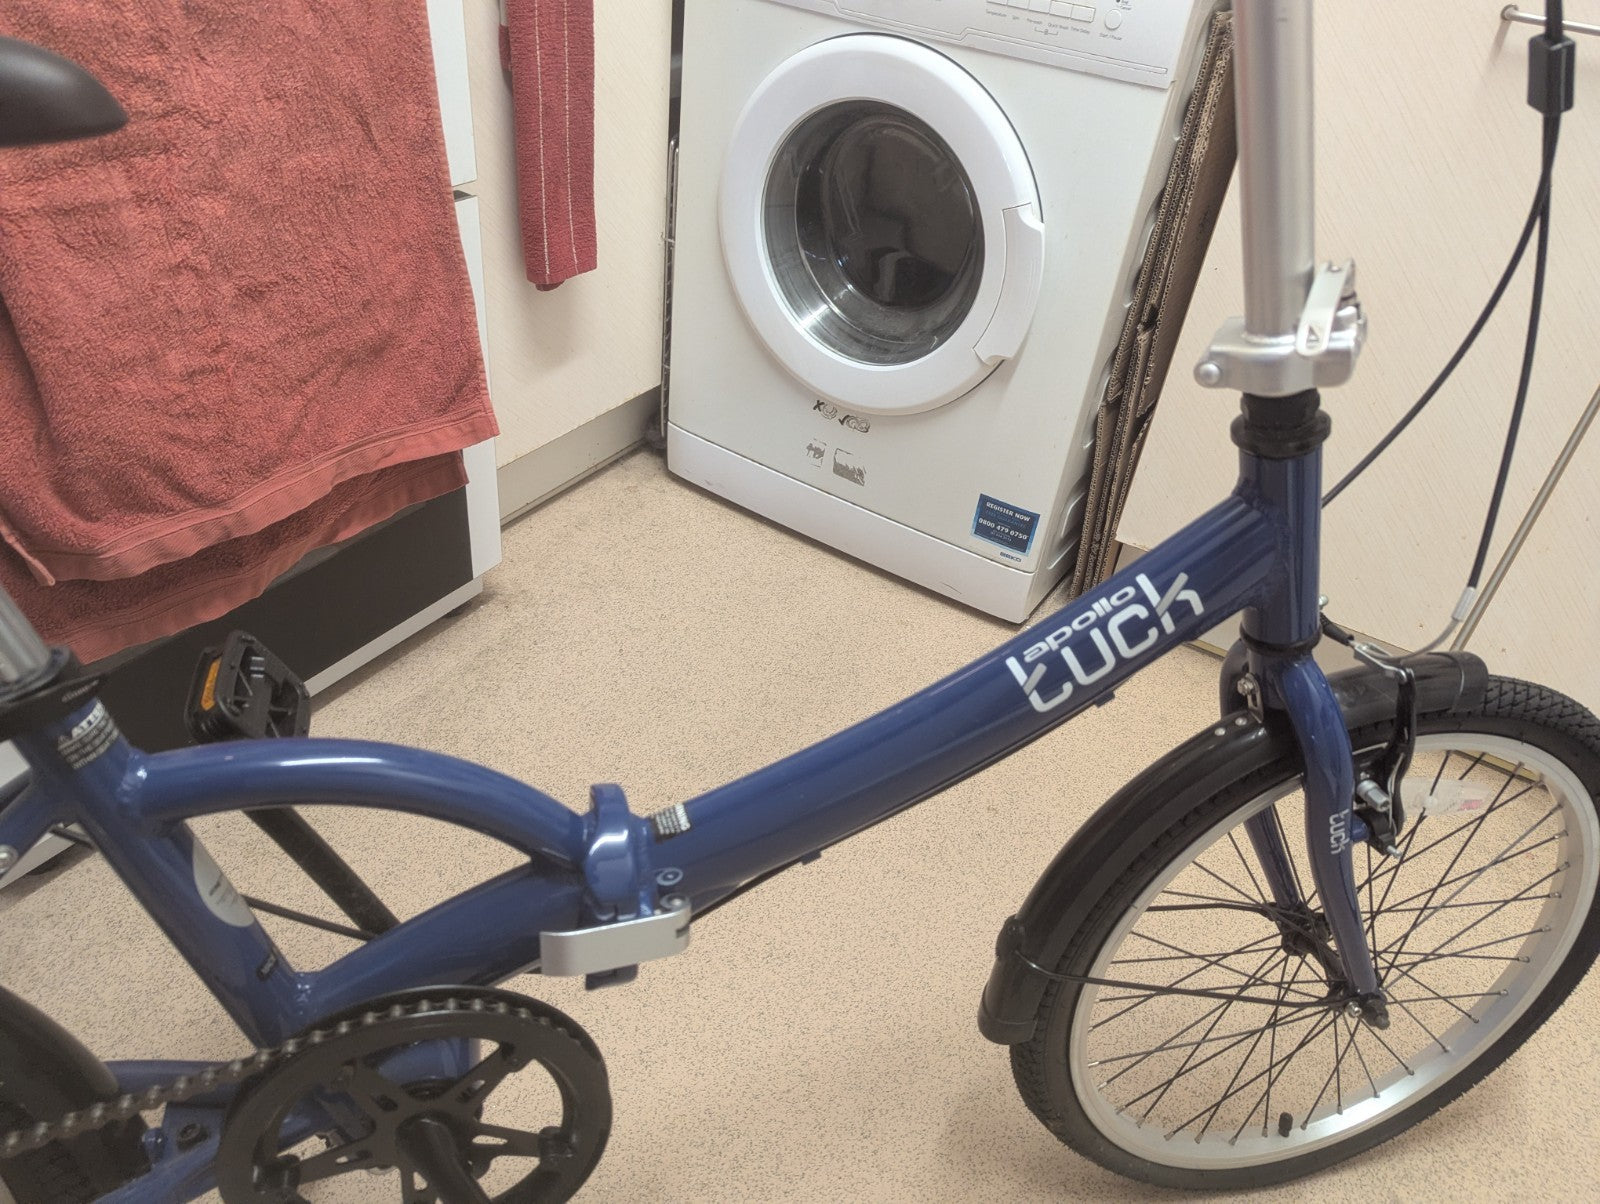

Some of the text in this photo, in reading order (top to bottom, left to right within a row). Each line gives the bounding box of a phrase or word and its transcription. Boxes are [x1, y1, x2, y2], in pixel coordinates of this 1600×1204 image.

[978, 517, 995, 528] 0800
[996, 525, 1009, 533] 479
[986, 501, 1014, 516] REGISTER
[1015, 512, 1031, 522] NOW
[1005, 572, 1205, 713] tuck
[1023, 586, 1136, 663] apollo
